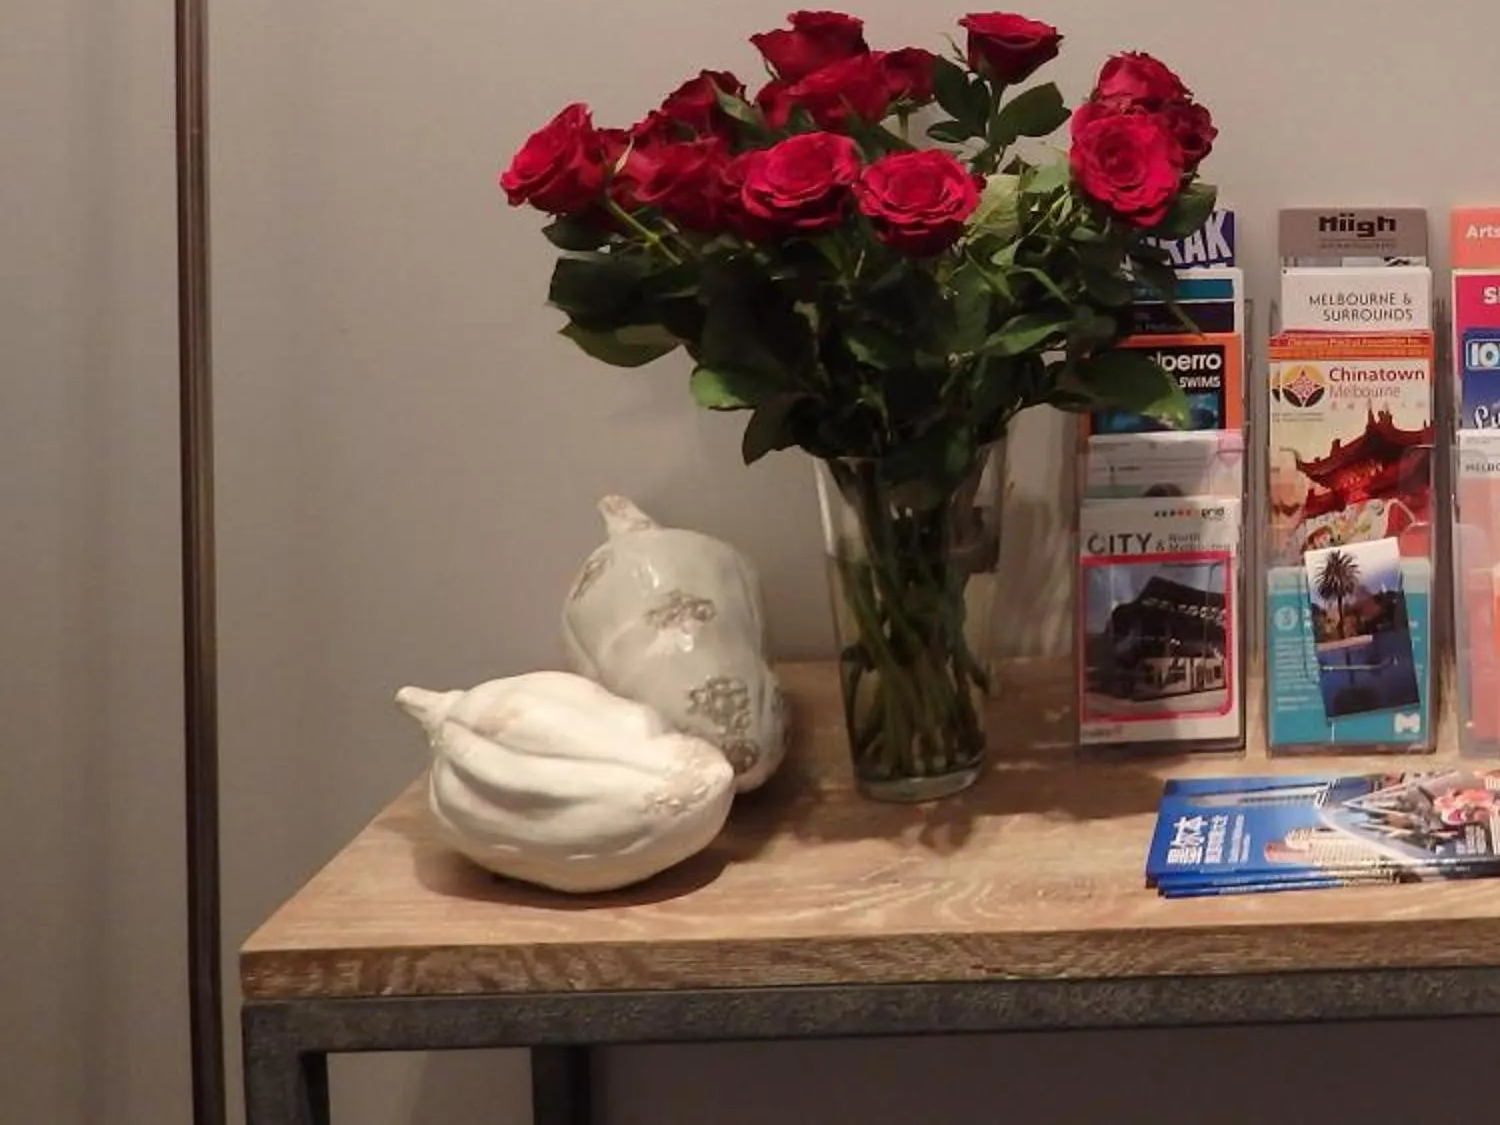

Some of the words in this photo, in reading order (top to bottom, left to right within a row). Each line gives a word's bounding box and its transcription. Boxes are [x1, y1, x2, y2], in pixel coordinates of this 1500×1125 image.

[1309, 293, 1396, 306] MELBOURNE
[1403, 293, 1412, 305] &
[1323, 308, 1413, 322] SURROUNDS
[1329, 366, 1425, 382] Chinatown
[1329, 384, 1401, 399] Melbourne
[1088, 532, 1153, 554] CITY
